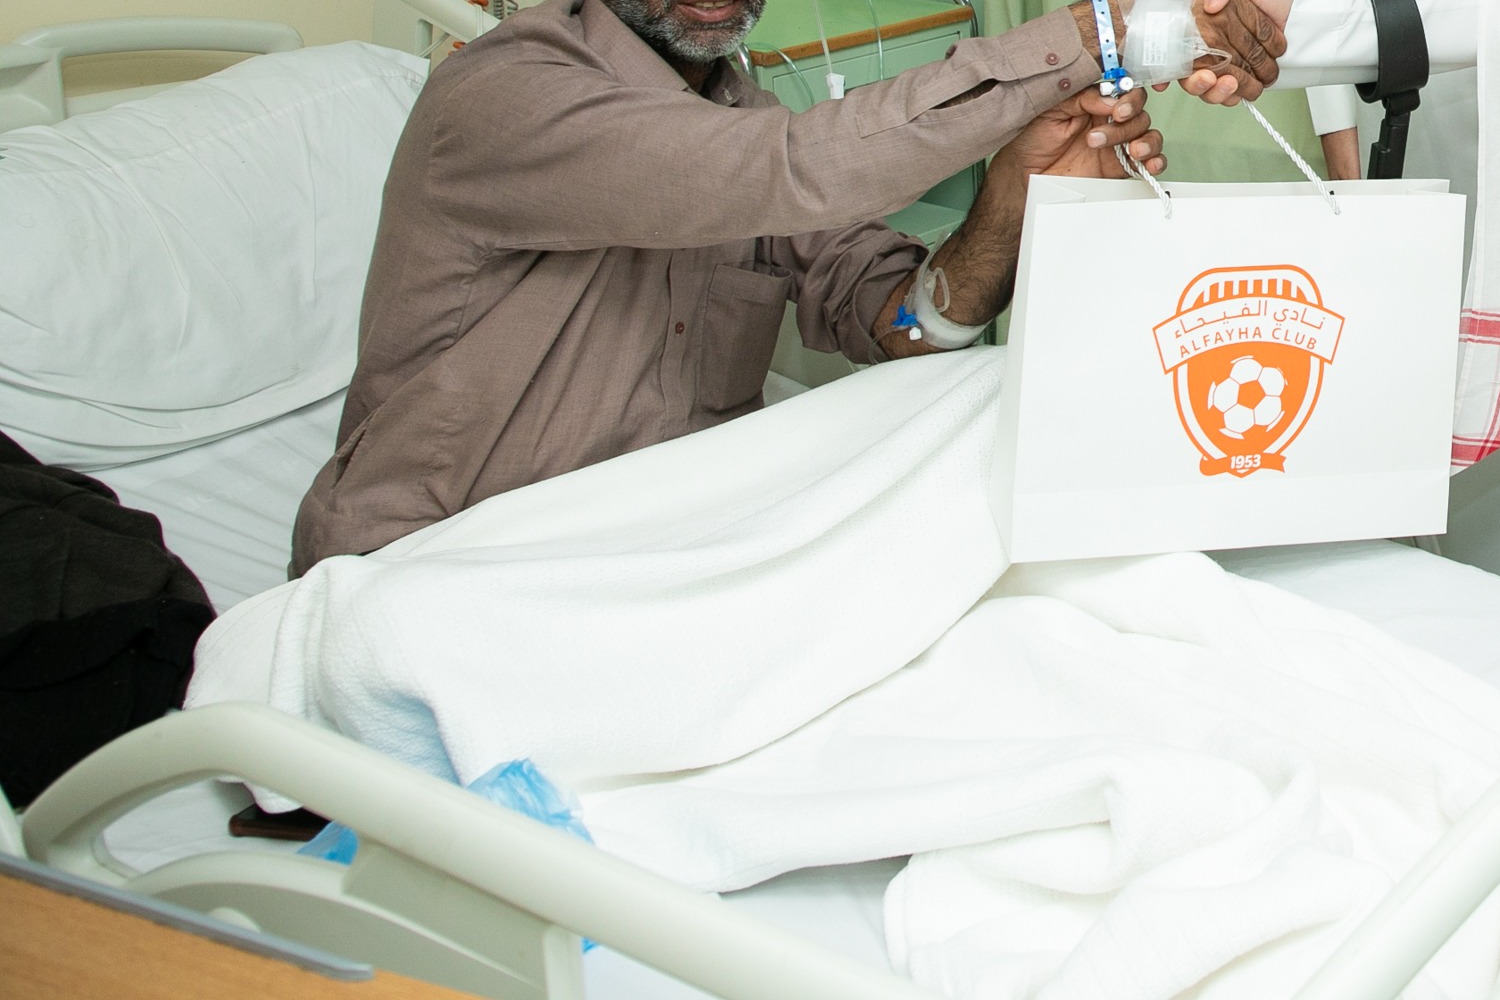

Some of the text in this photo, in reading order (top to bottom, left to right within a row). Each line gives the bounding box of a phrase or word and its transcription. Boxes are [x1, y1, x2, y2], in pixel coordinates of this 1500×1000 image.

[1174, 300, 1326, 339] نادي الفيحاء
[1179, 326, 1318, 359] ALFAYHA CLUB
[1230, 454, 1262, 469] 1953
